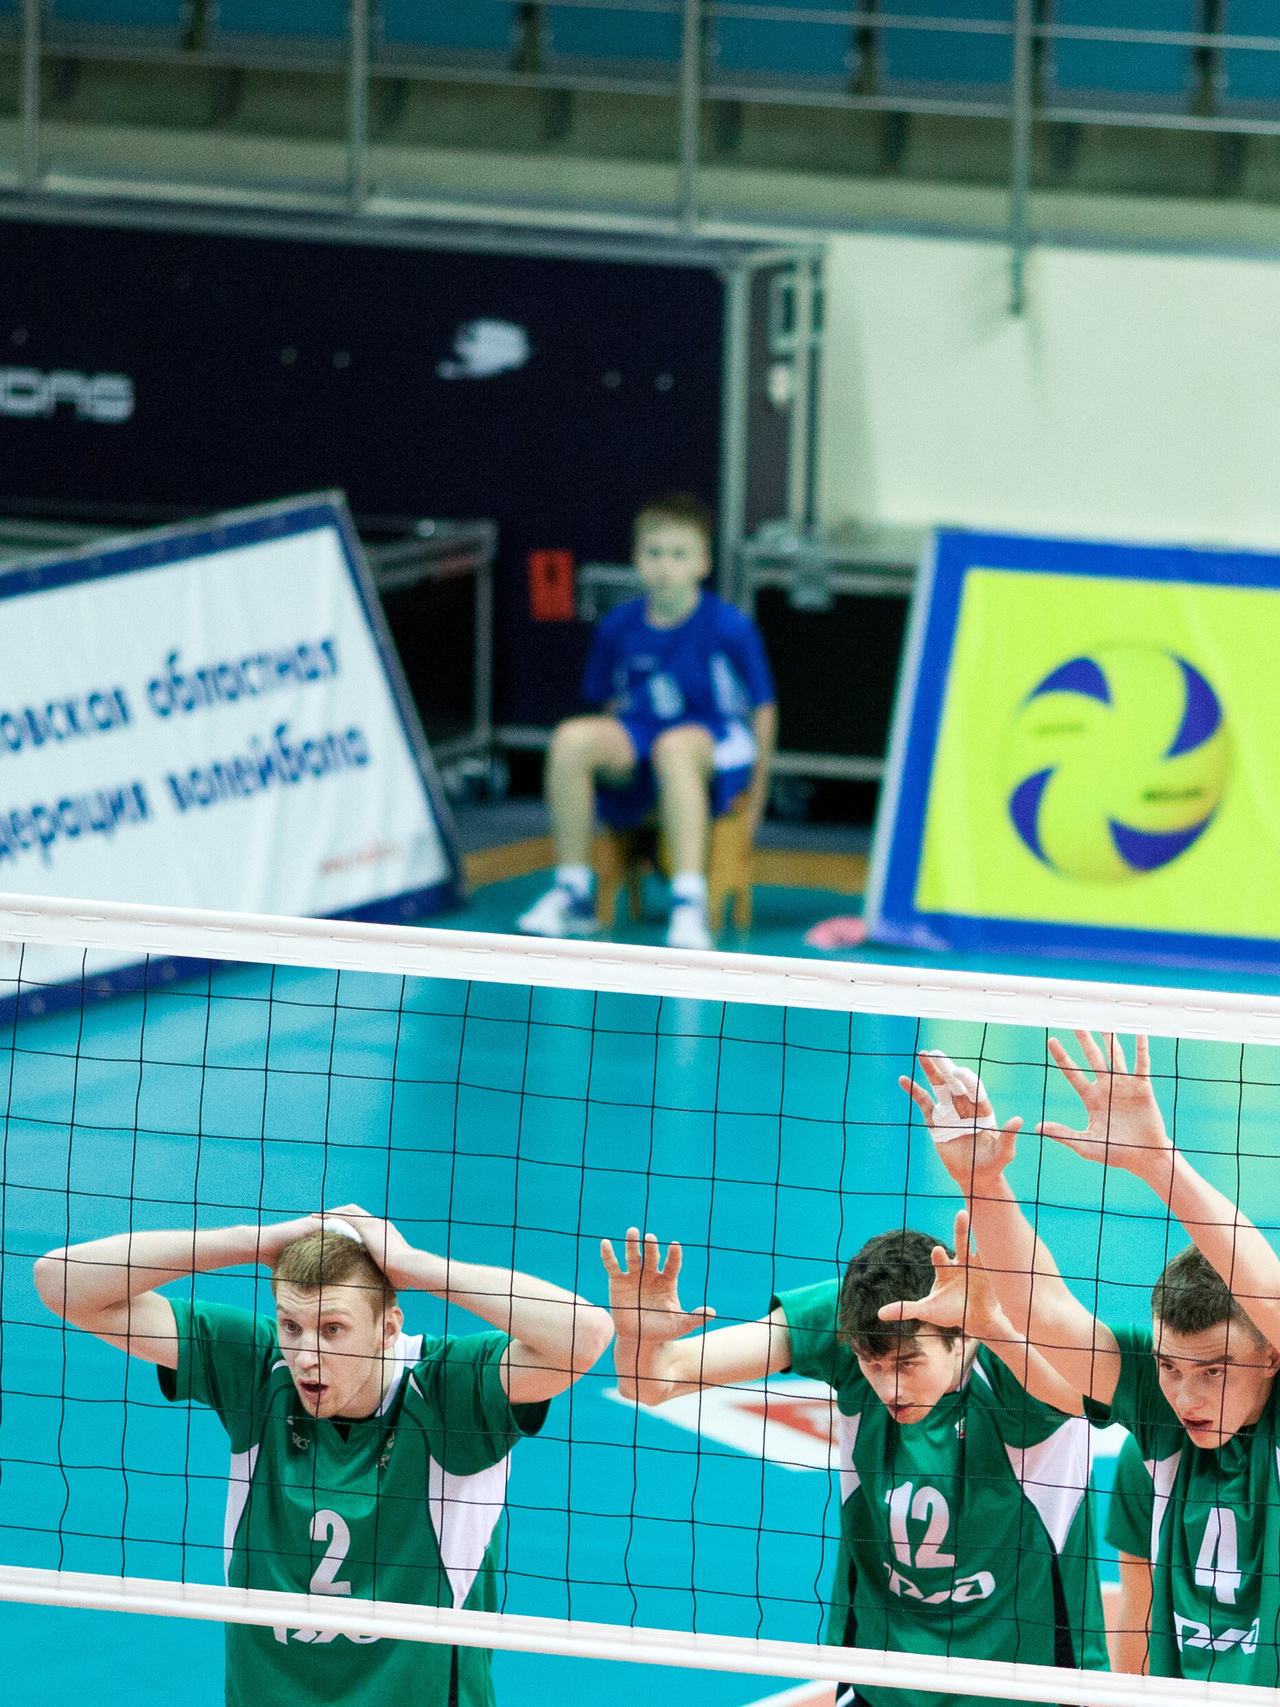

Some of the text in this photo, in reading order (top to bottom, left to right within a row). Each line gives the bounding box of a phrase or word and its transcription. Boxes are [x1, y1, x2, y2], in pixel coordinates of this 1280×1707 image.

[145, 637, 340, 718] областная
[164, 720, 372, 815] волейбола
[309, 1509, 352, 1595] 2
[885, 1481, 957, 1569] 12
[1195, 1507, 1242, 1605] 4
